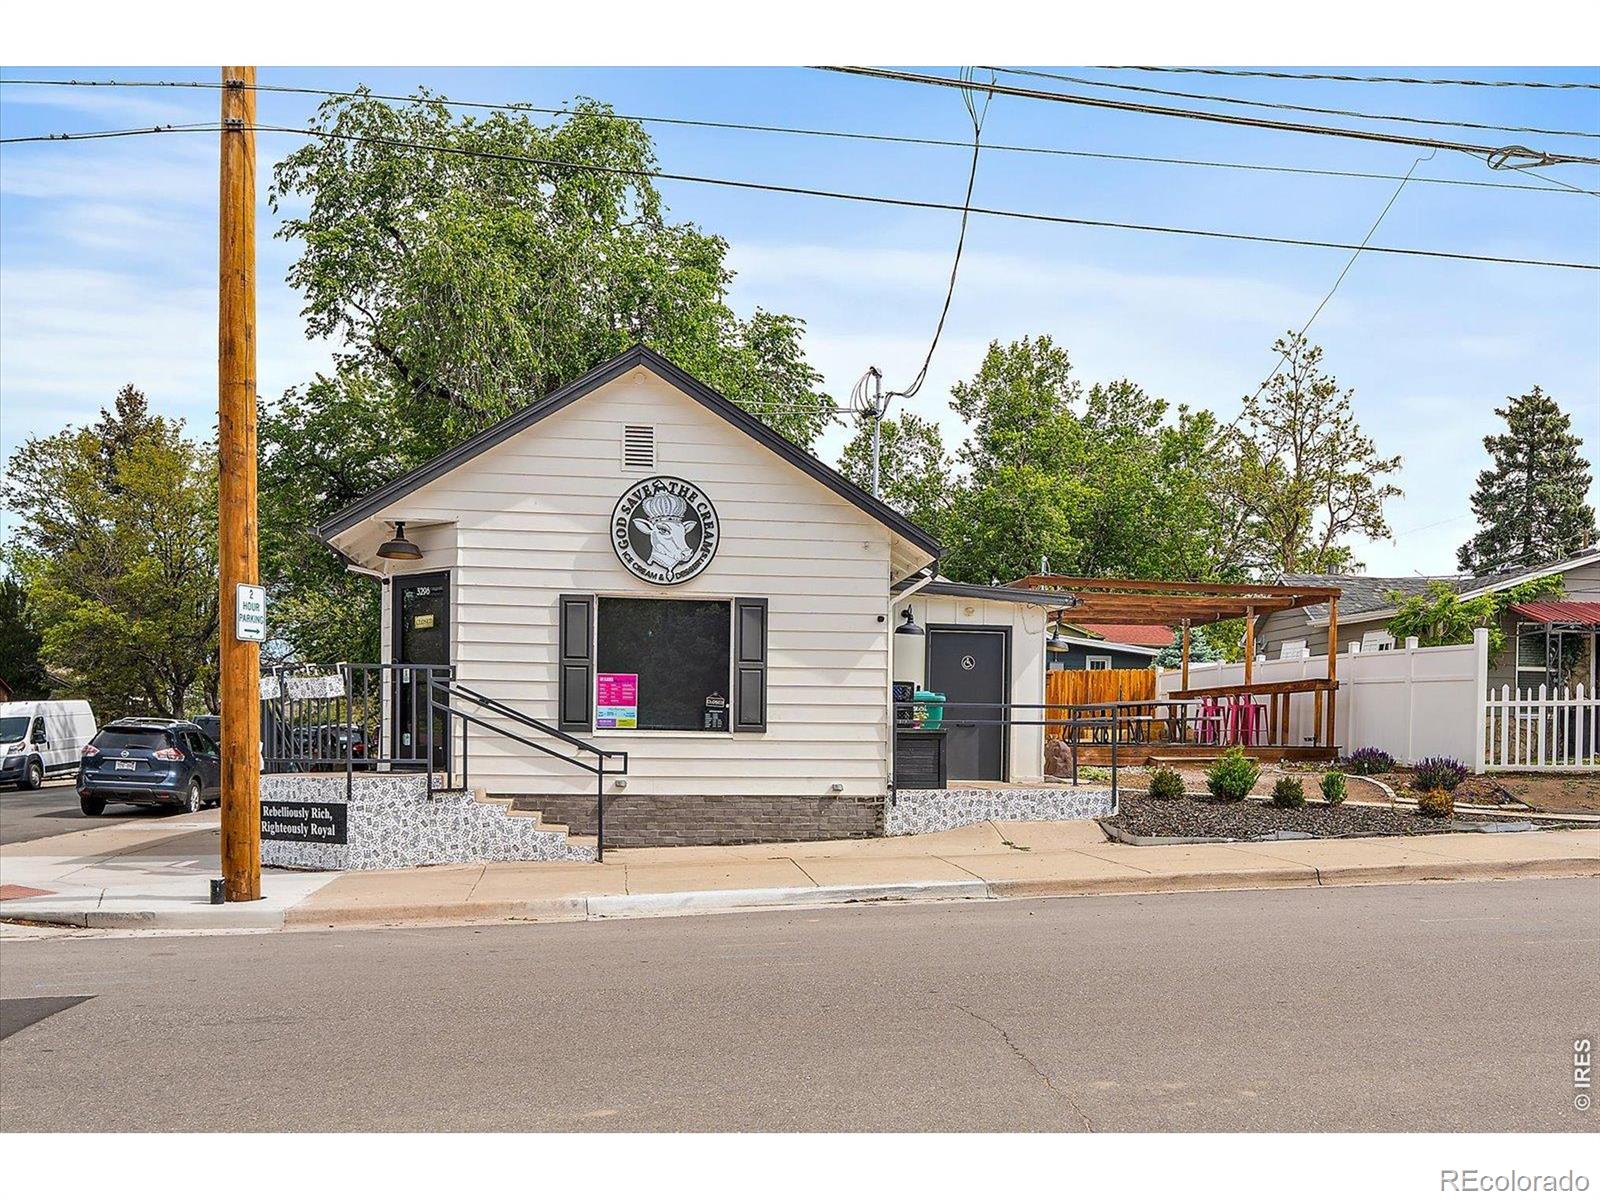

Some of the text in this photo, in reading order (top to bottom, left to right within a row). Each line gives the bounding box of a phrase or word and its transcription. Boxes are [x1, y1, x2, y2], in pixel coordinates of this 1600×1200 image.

[615, 481, 715, 555] GOD SAVE THE CREAM
[621, 550, 635, 565] ICE
[632, 562, 658, 580] CREAM
[675, 552, 708, 580] DESSERTS
[249, 589, 254, 600] 2
[242, 600, 260, 612] HOUR
[239, 613, 265, 625] PARKING
[262, 805, 333, 822] Rebelliously Rich,
[261, 820, 336, 839] Righteously Royal
